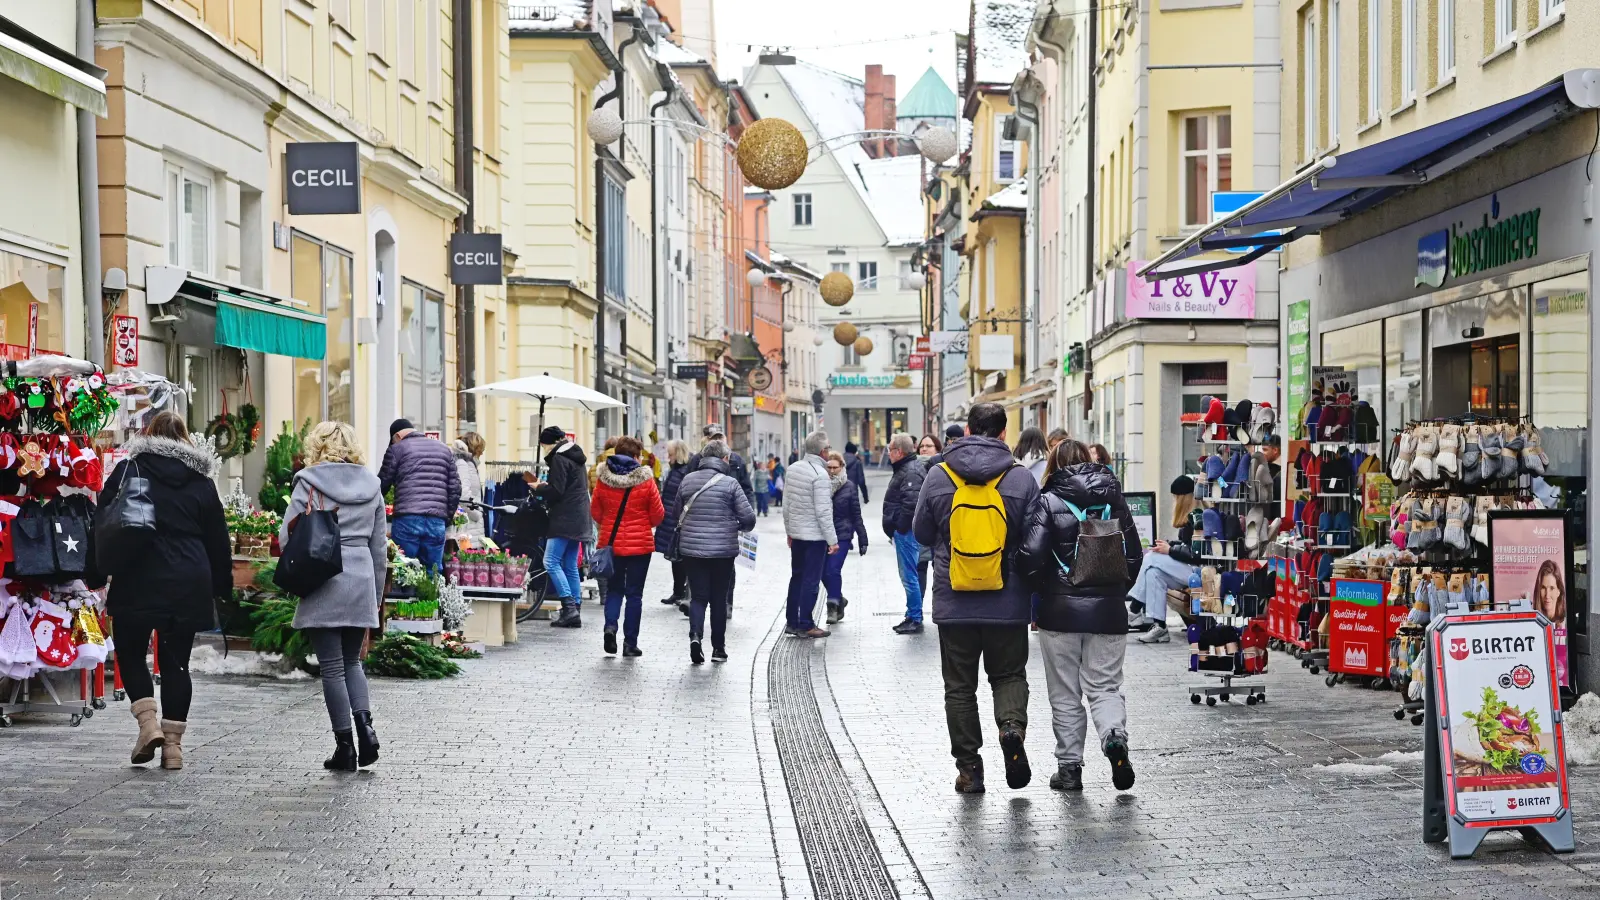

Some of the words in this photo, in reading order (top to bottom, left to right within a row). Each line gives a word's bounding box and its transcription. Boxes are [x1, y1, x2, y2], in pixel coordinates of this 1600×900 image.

[291, 169, 354, 187] CECIL
[453, 252, 499, 266] CECIL
[1172, 275, 1193, 298] &
[1197, 271, 1238, 306] Vy
[1148, 301, 1172, 313] Nails
[1174, 301, 1182, 313] &
[1184, 301, 1218, 314] Beauty
[1337, 587, 1379, 602] Reformhaus
[1333, 609, 1357, 619] Qualität
[1357, 609, 1368, 620] hat
[1338, 621, 1353, 631] einen
[1472, 635, 1535, 654] BIRTAT
[1518, 796, 1551, 808] BIRTAT
